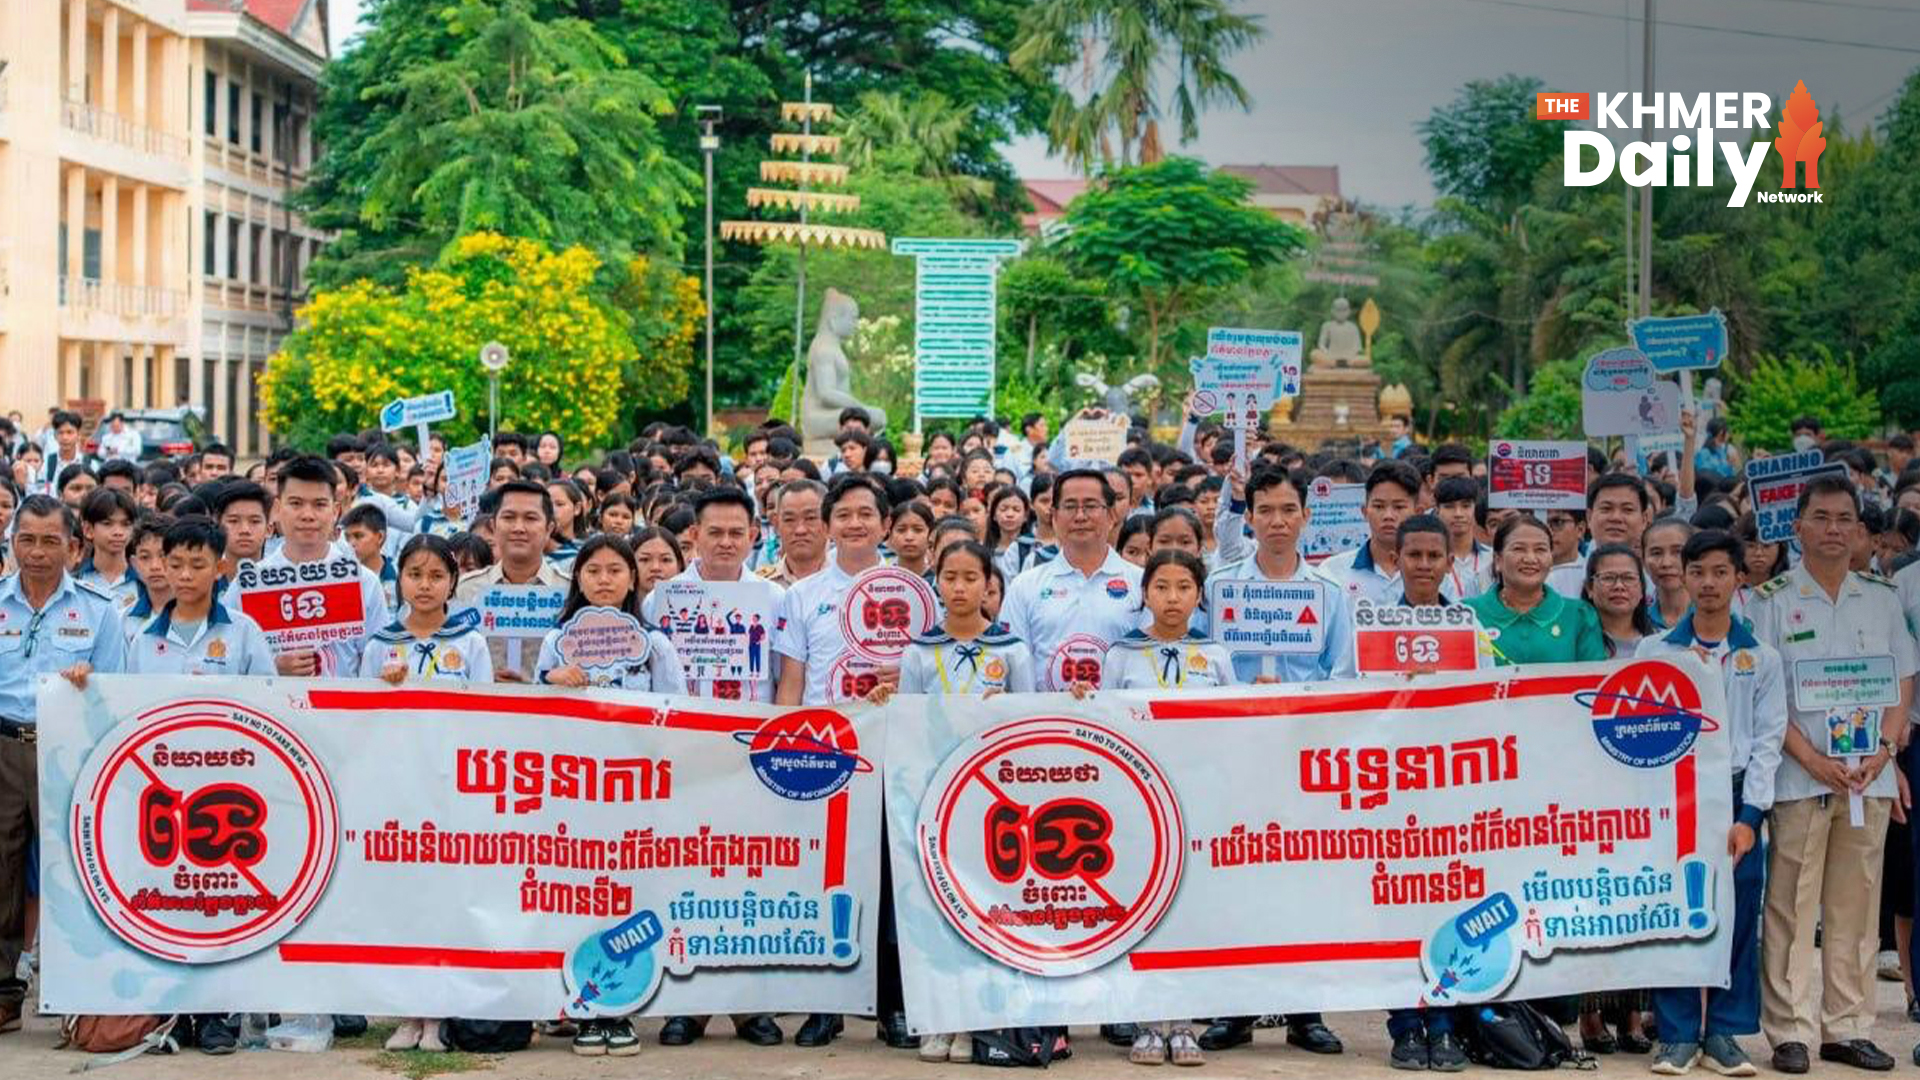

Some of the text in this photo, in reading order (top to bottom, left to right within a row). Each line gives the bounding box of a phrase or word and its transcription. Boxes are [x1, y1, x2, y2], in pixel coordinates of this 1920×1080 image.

[1524, 463, 1551, 485] ទេ
[239, 558, 358, 588] និយាយថា
[280, 590, 327, 622] ទេ
[862, 598, 911, 630] ទេ
[1356, 600, 1474, 626] និយាយថា
[1395, 634, 1440, 663] ទេ
[1062, 657, 1101, 683] ទេ
[1075, 728, 1093, 739] SAY
[1104, 738, 1116, 749] TO
[1600, 735, 1631, 763] MINISTRY
[1647, 731, 1695, 766] INFORMATION
[153, 743, 255, 767] និយាយថា
[457, 749, 671, 814] យុទ្ធនាការ
[757, 766, 850, 799] MINISTRY OF INFORMATION
[998, 760, 1099, 783] និយាយថា
[1300, 735, 1518, 810] យុទ្ធនាការ
[141, 784, 266, 865] ទេ
[986, 799, 1112, 881] ទេ
[173, 865, 239, 890] ចំពោះ
[520, 867, 632, 916] ជំហានទី២
[1022, 879, 1087, 903] ចំពោះ
[1372, 860, 1485, 905] ជំហានទី២
[1463, 900, 1510, 939] WAIT
[608, 918, 657, 954] WAIT
